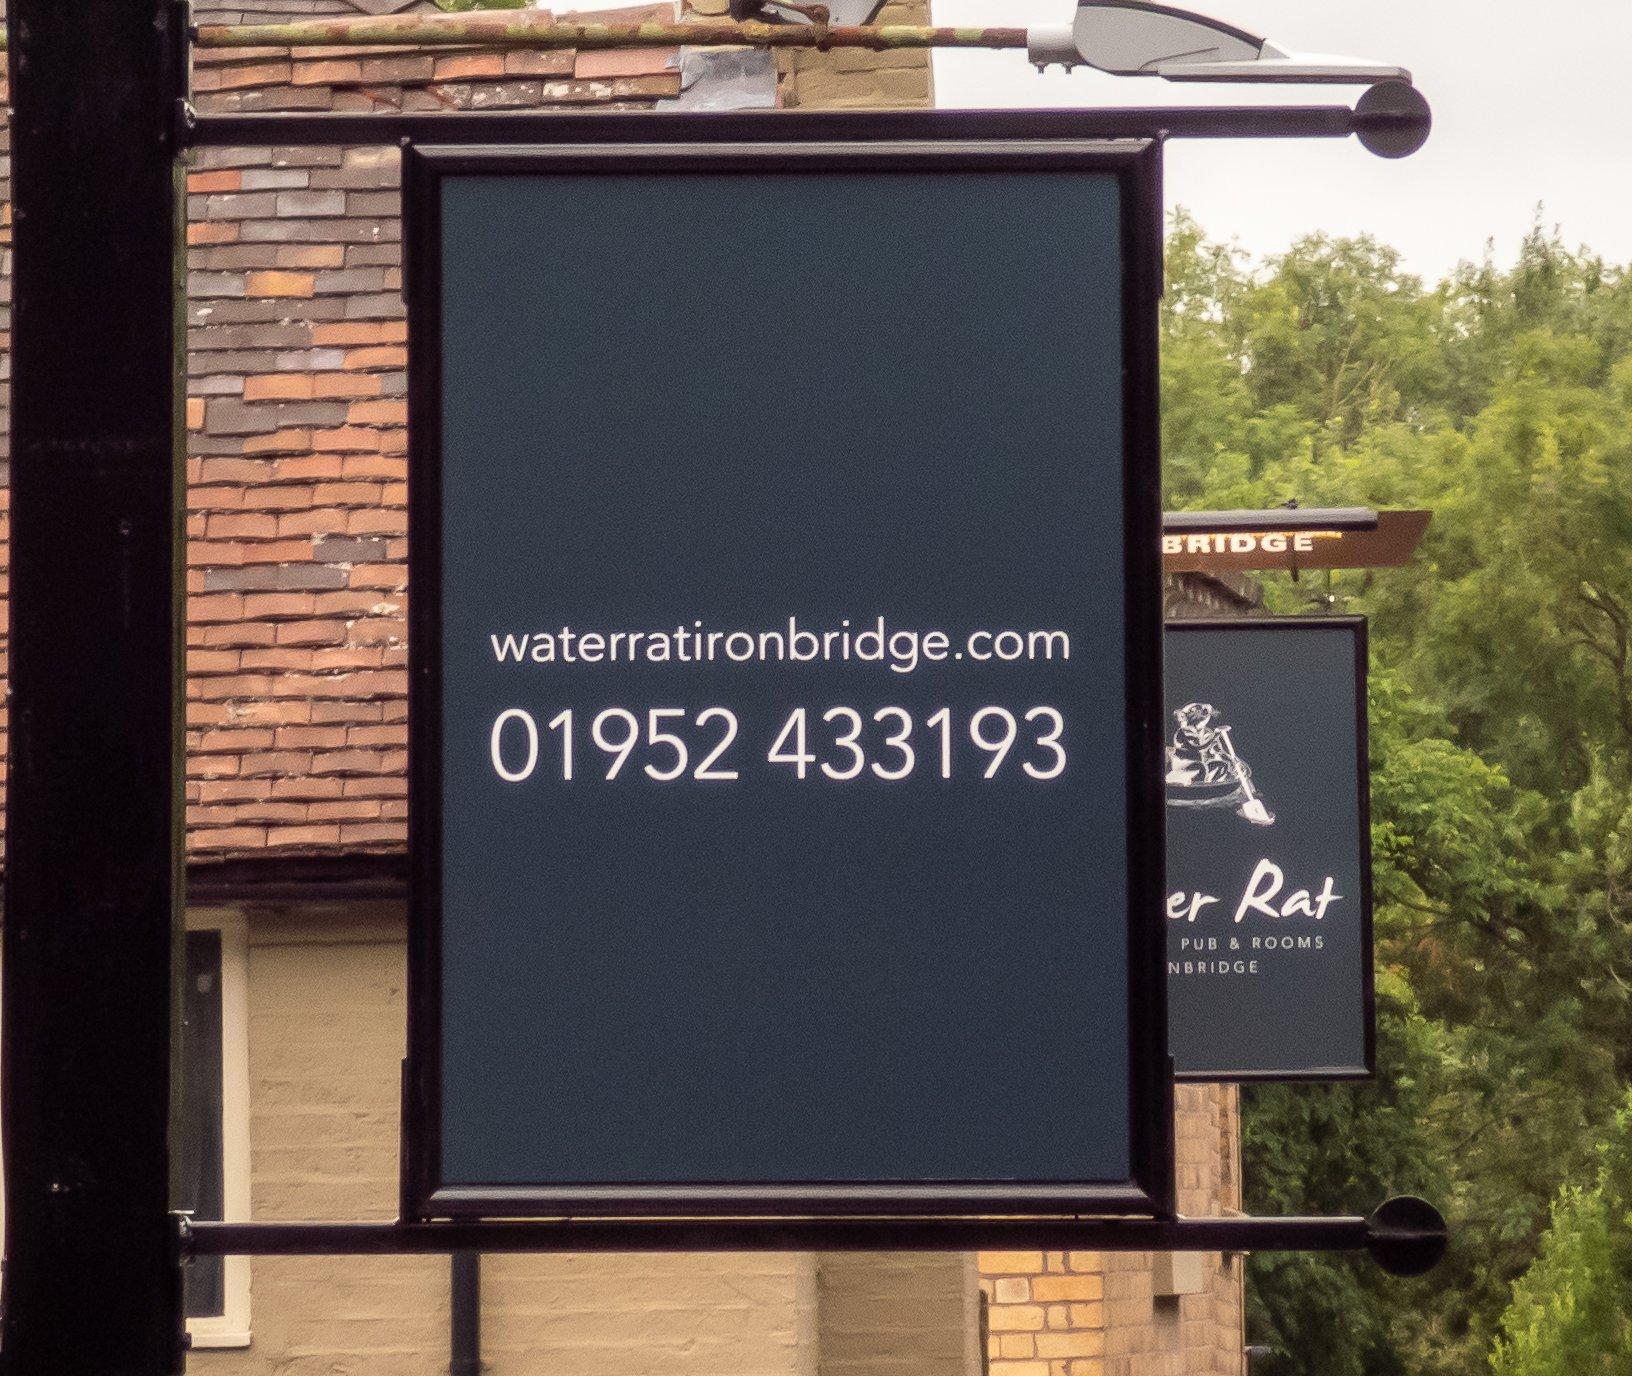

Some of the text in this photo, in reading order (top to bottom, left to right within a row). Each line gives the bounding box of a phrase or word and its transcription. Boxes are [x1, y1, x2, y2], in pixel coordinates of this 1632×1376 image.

[489, 615, 1071, 674] waterratironbridge.com
[489, 706, 1068, 783] 01952 433193
[1234, 857, 1344, 924] Rat
[1181, 935, 1324, 951] PUB & ROOMS
